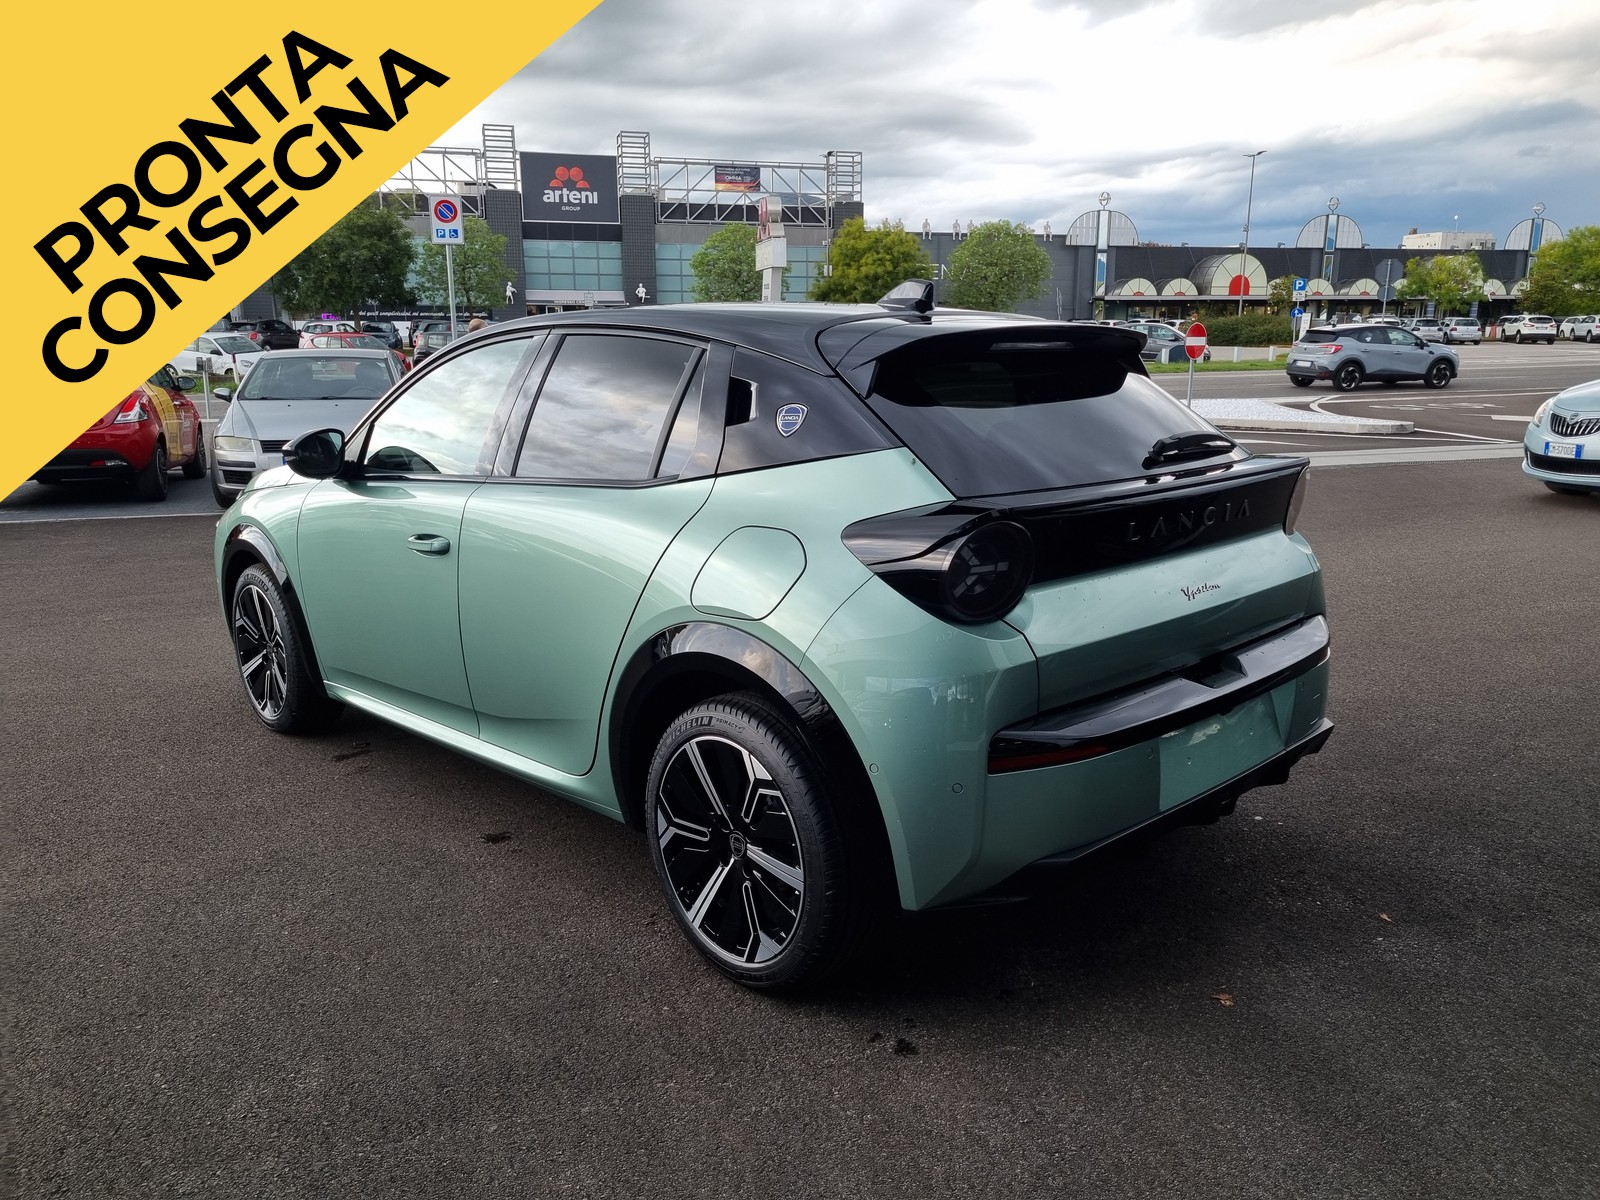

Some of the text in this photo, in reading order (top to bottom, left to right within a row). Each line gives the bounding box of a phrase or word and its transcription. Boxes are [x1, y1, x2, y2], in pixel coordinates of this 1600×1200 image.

[542, 187, 598, 204] arteni
[1295, 280, 1304, 290] P
[1129, 499, 1250, 541] LANCIA
[1180, 582, 1221, 602] Ypsilon
[665, 716, 738, 746] MICHELIN PRIMACY
